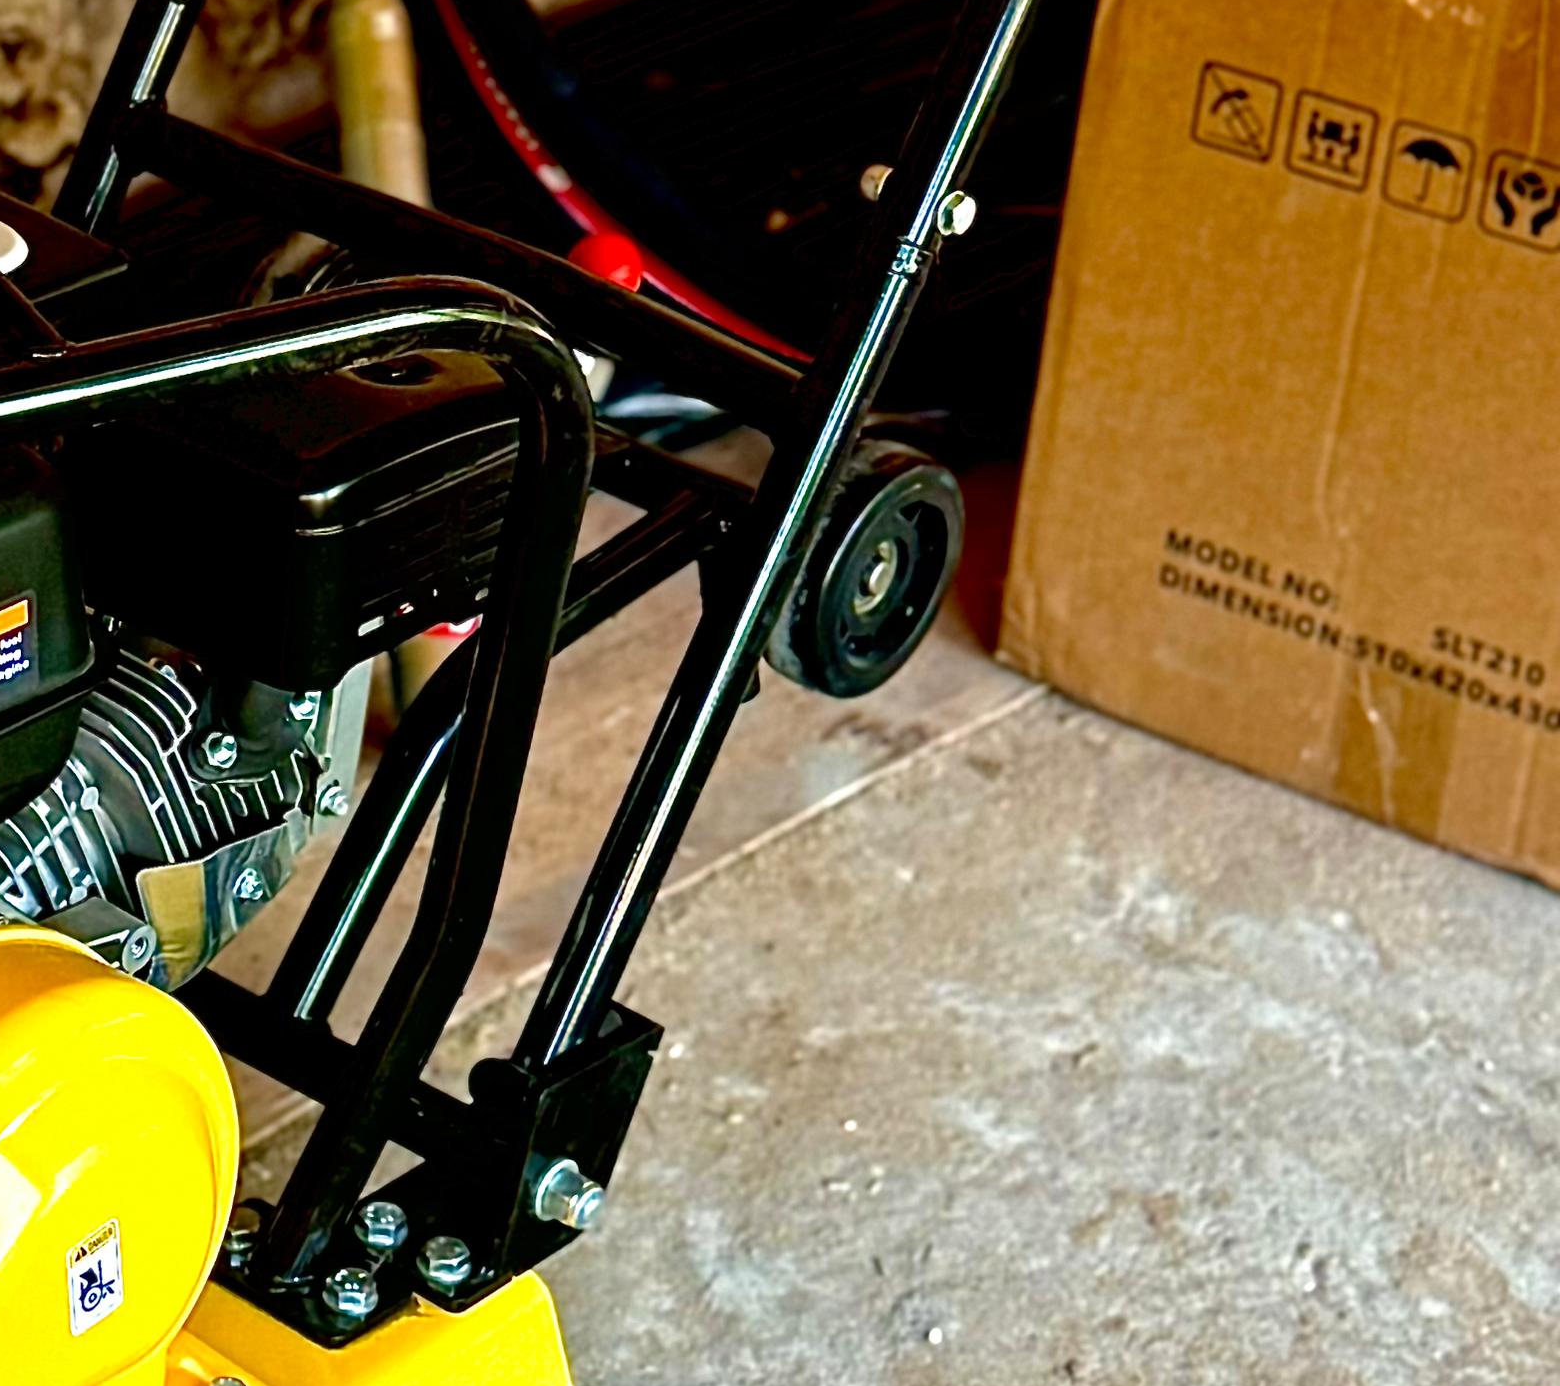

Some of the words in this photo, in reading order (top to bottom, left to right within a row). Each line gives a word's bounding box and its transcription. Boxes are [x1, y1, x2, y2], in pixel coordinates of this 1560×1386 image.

[0, 631, 23, 650] fuel
[1164, 528, 1275, 588] MODEL
[1281, 569, 1340, 611] NO:
[1432, 625, 1547, 687] SLT210
